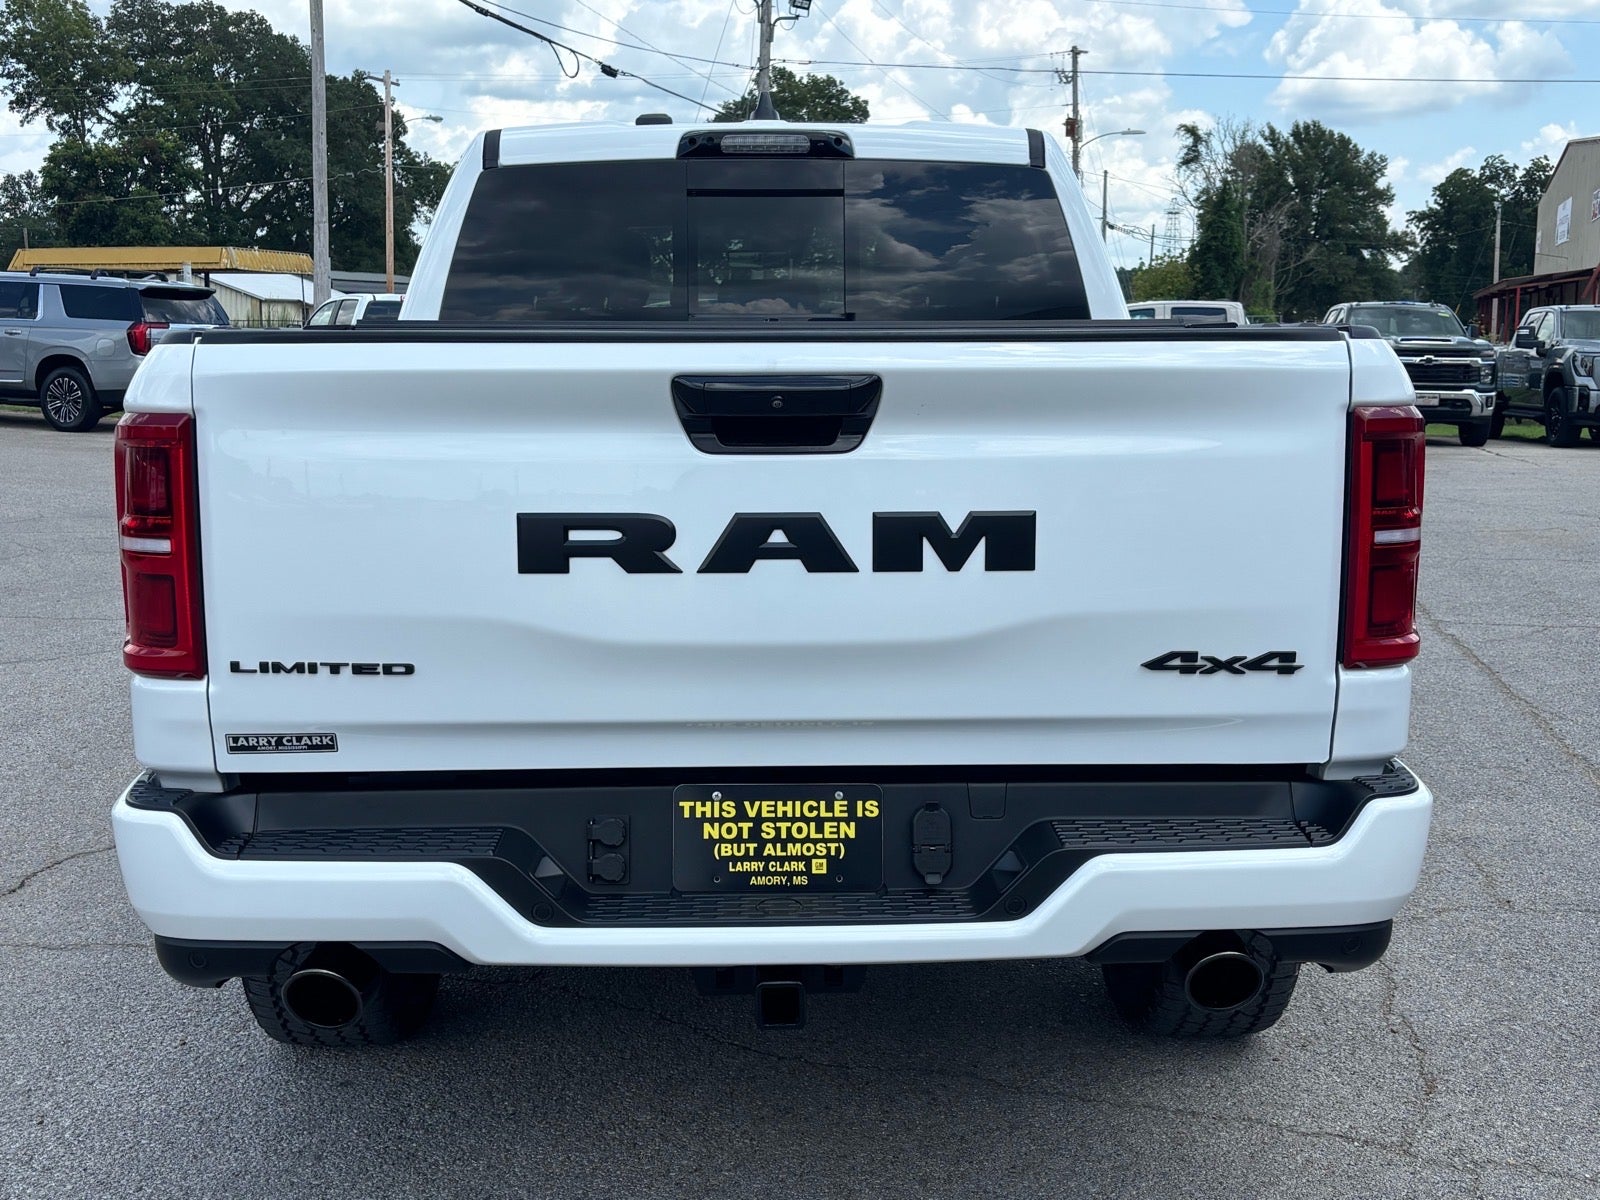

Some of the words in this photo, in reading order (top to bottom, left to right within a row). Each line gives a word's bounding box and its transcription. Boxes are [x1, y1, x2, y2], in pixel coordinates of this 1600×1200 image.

[516, 510, 1037, 574] RAM
[229, 660, 416, 676] LIMITED
[1140, 650, 1305, 675] 4x4
[229, 736, 278, 747] LARRY
[282, 736, 334, 746] CLARK
[679, 800, 737, 818] THIS
[744, 800, 849, 818] VEHICLE
[857, 800, 880, 818] IS
[703, 822, 753, 839] NOT
[760, 822, 856, 839] STOLEN
[713, 843, 758, 860] (BUT
[763, 843, 846, 860] ALMOST)
[728, 861, 765, 872] LARRY
[768, 861, 806, 872] CLARK
[749, 876, 791, 886] AMORY,
[792, 876, 809, 885] MS
